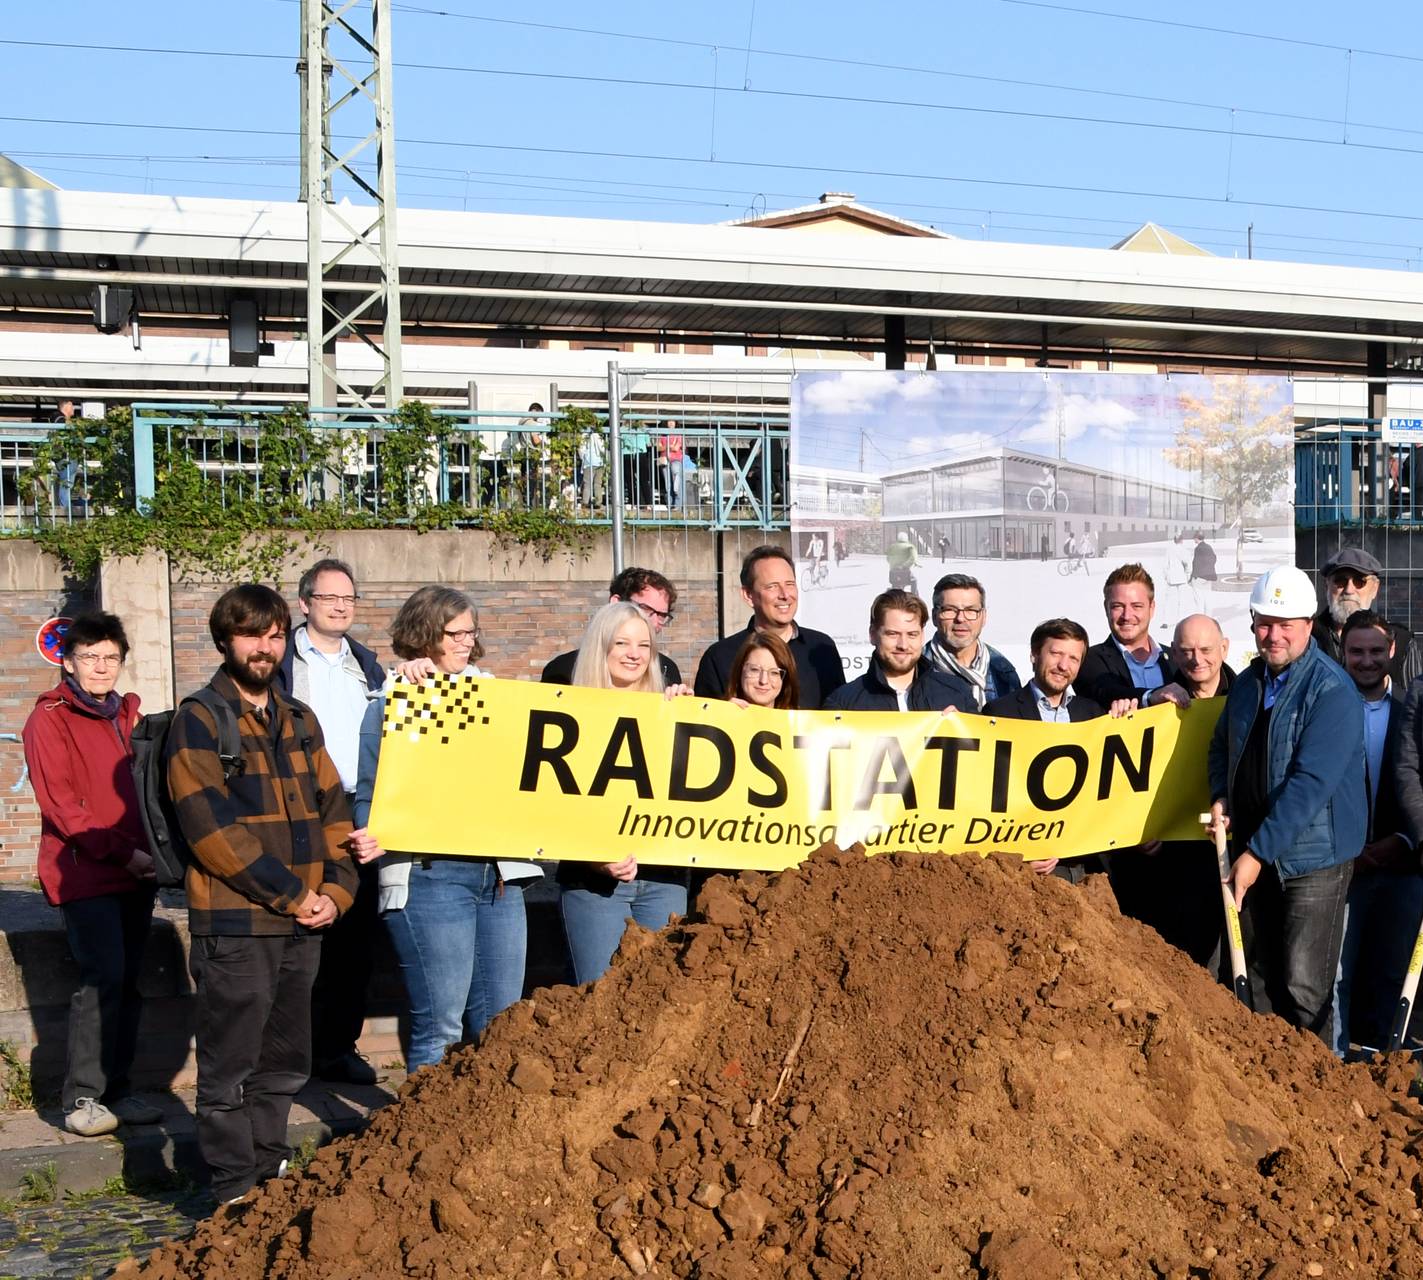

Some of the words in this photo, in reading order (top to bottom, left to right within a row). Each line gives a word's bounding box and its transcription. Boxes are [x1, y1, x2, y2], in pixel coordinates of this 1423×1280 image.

[519, 709, 1155, 813] RADSTATION
[617, 804, 954, 847] Innovationsqartier
[964, 817, 1065, 846] Düren
